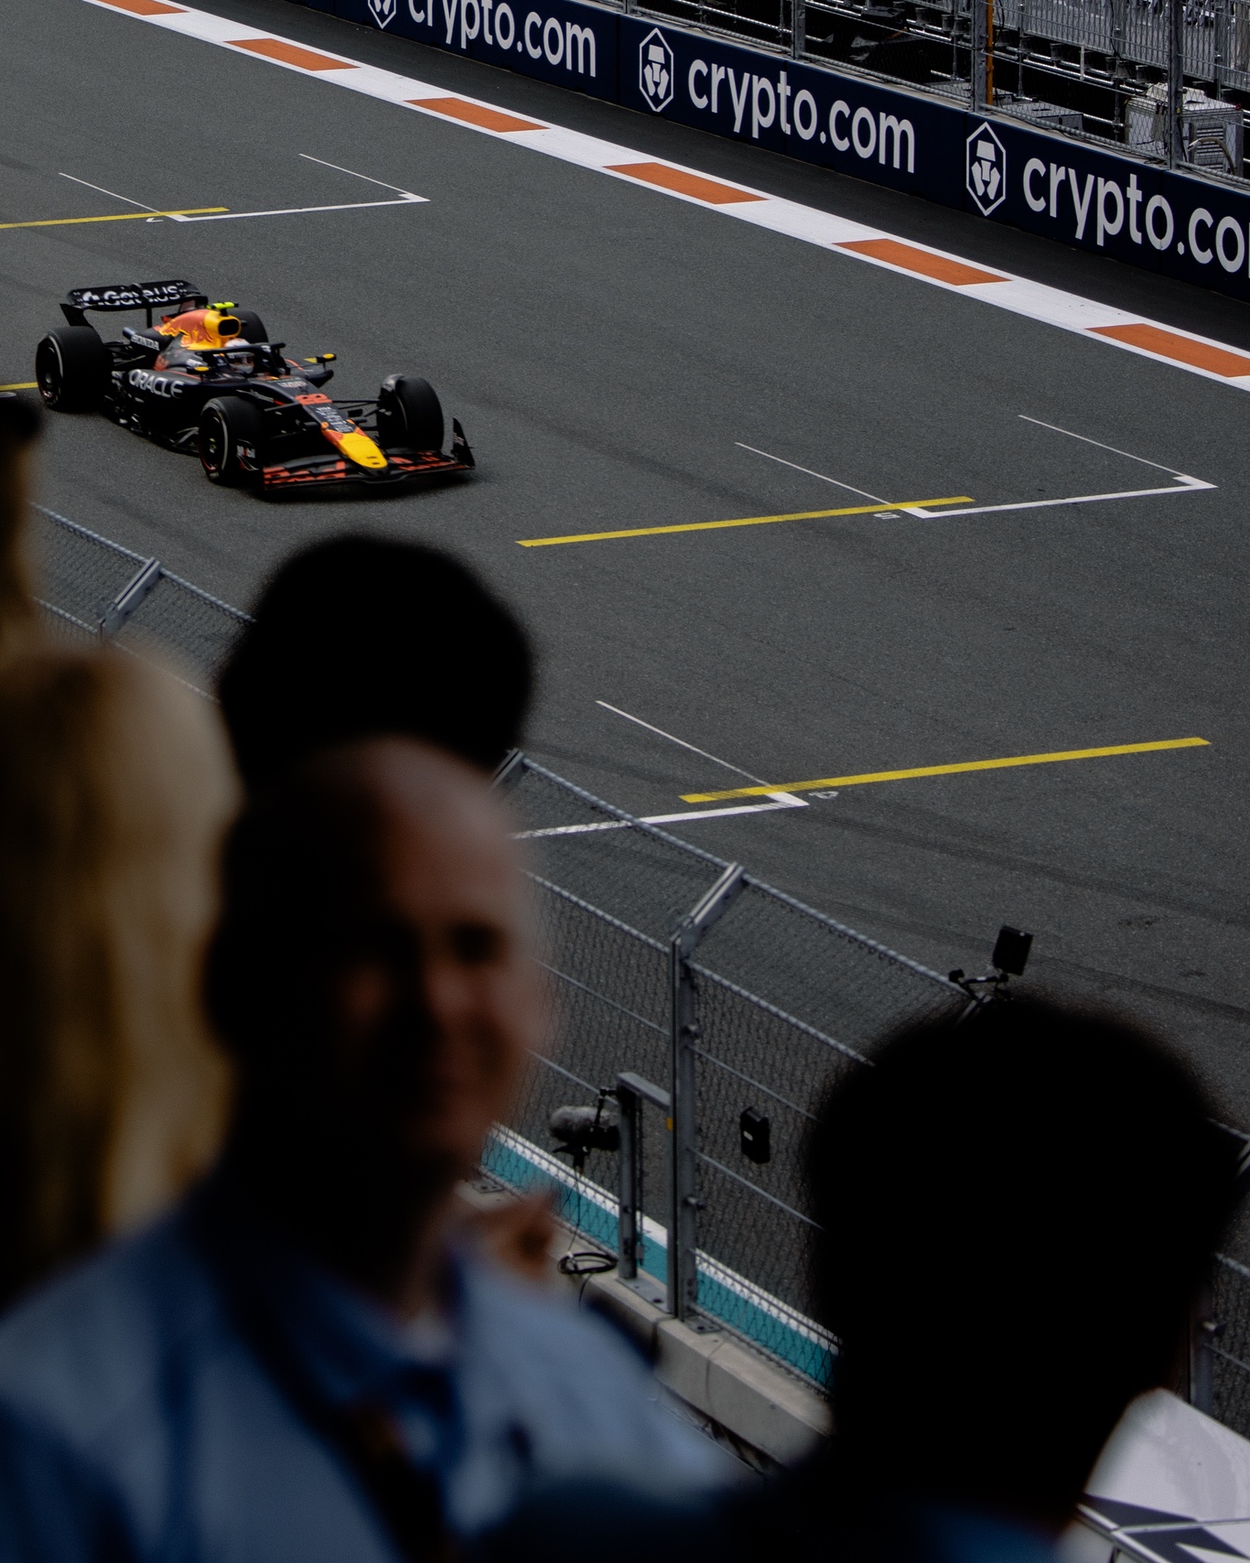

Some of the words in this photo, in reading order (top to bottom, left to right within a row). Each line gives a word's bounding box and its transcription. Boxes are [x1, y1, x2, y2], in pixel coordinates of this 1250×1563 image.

[688, 58, 916, 174] crypto.com
[1023, 157, 1250, 278] crypto.co
[130, 334, 161, 352] HONDA
[127, 368, 187, 400] ORACLE
